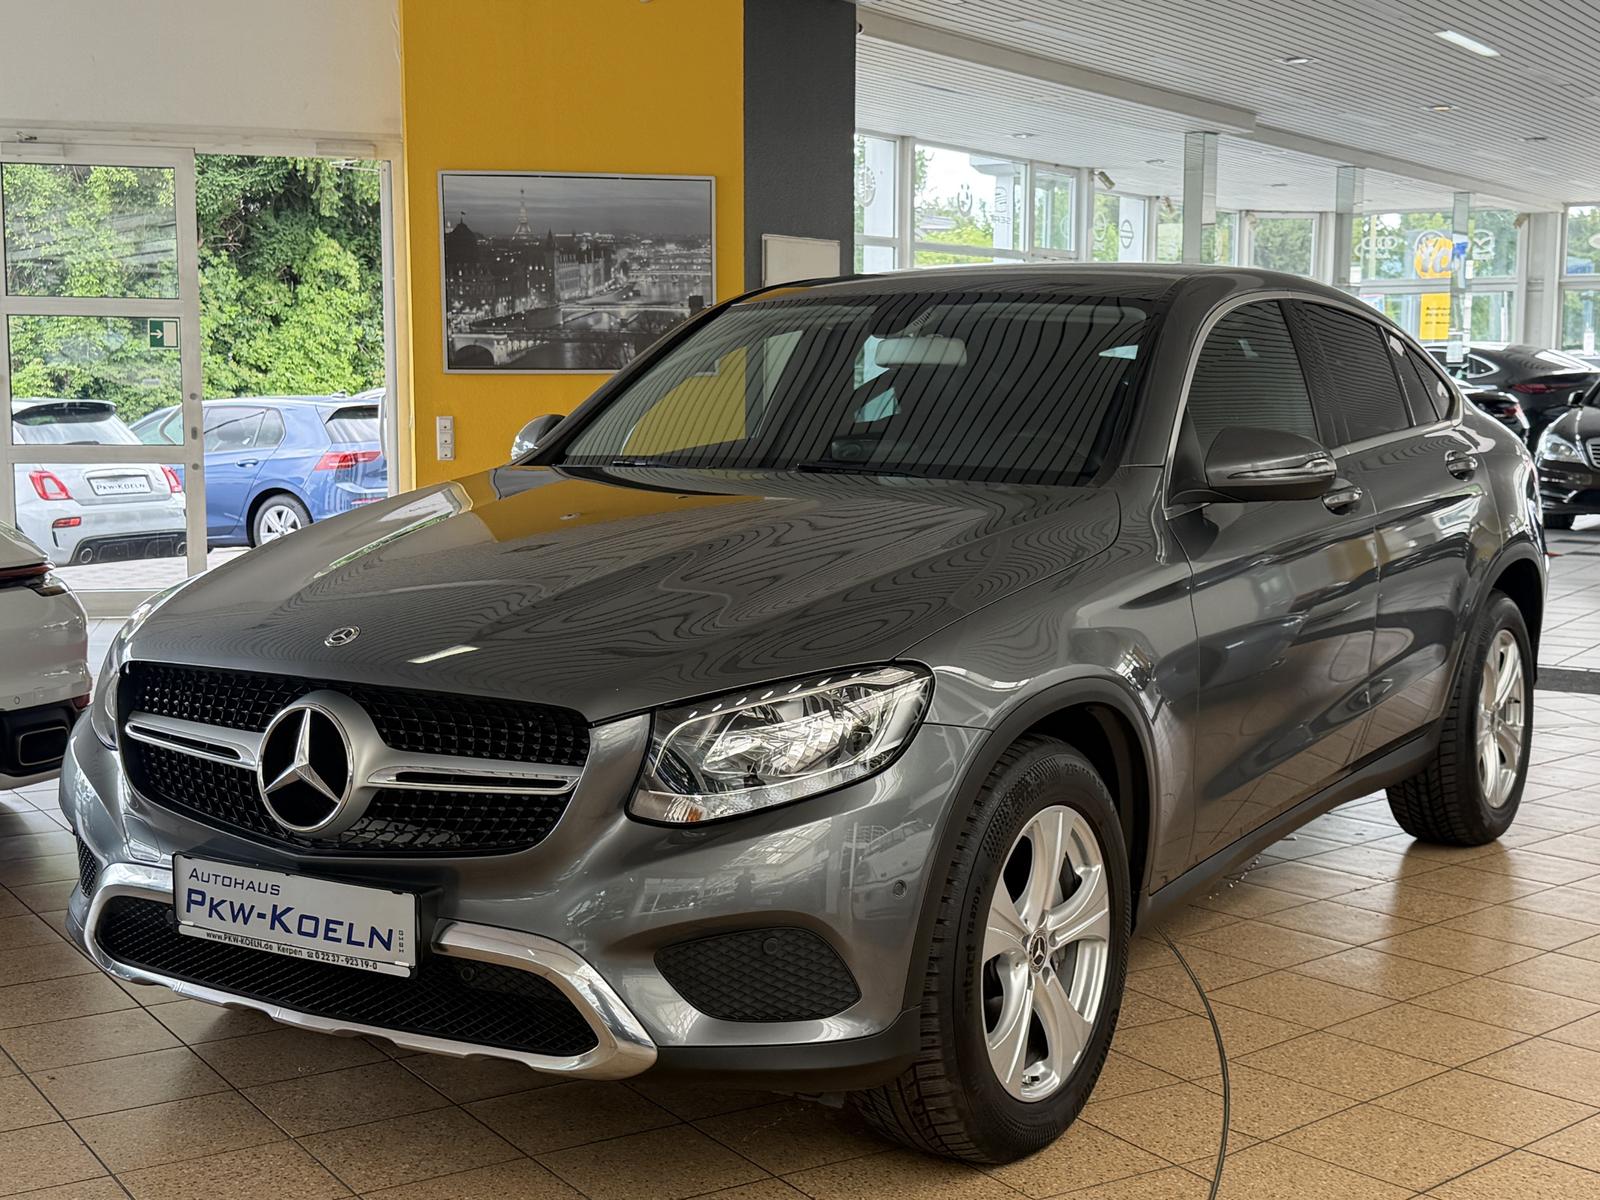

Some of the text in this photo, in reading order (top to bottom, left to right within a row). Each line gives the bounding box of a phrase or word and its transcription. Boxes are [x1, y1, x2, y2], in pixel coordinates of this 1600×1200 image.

[188, 867, 281, 896] AUTOHAUS
[185, 888, 394, 952] PKW-KOELN
[277, 943, 303, 957] Kerpen
